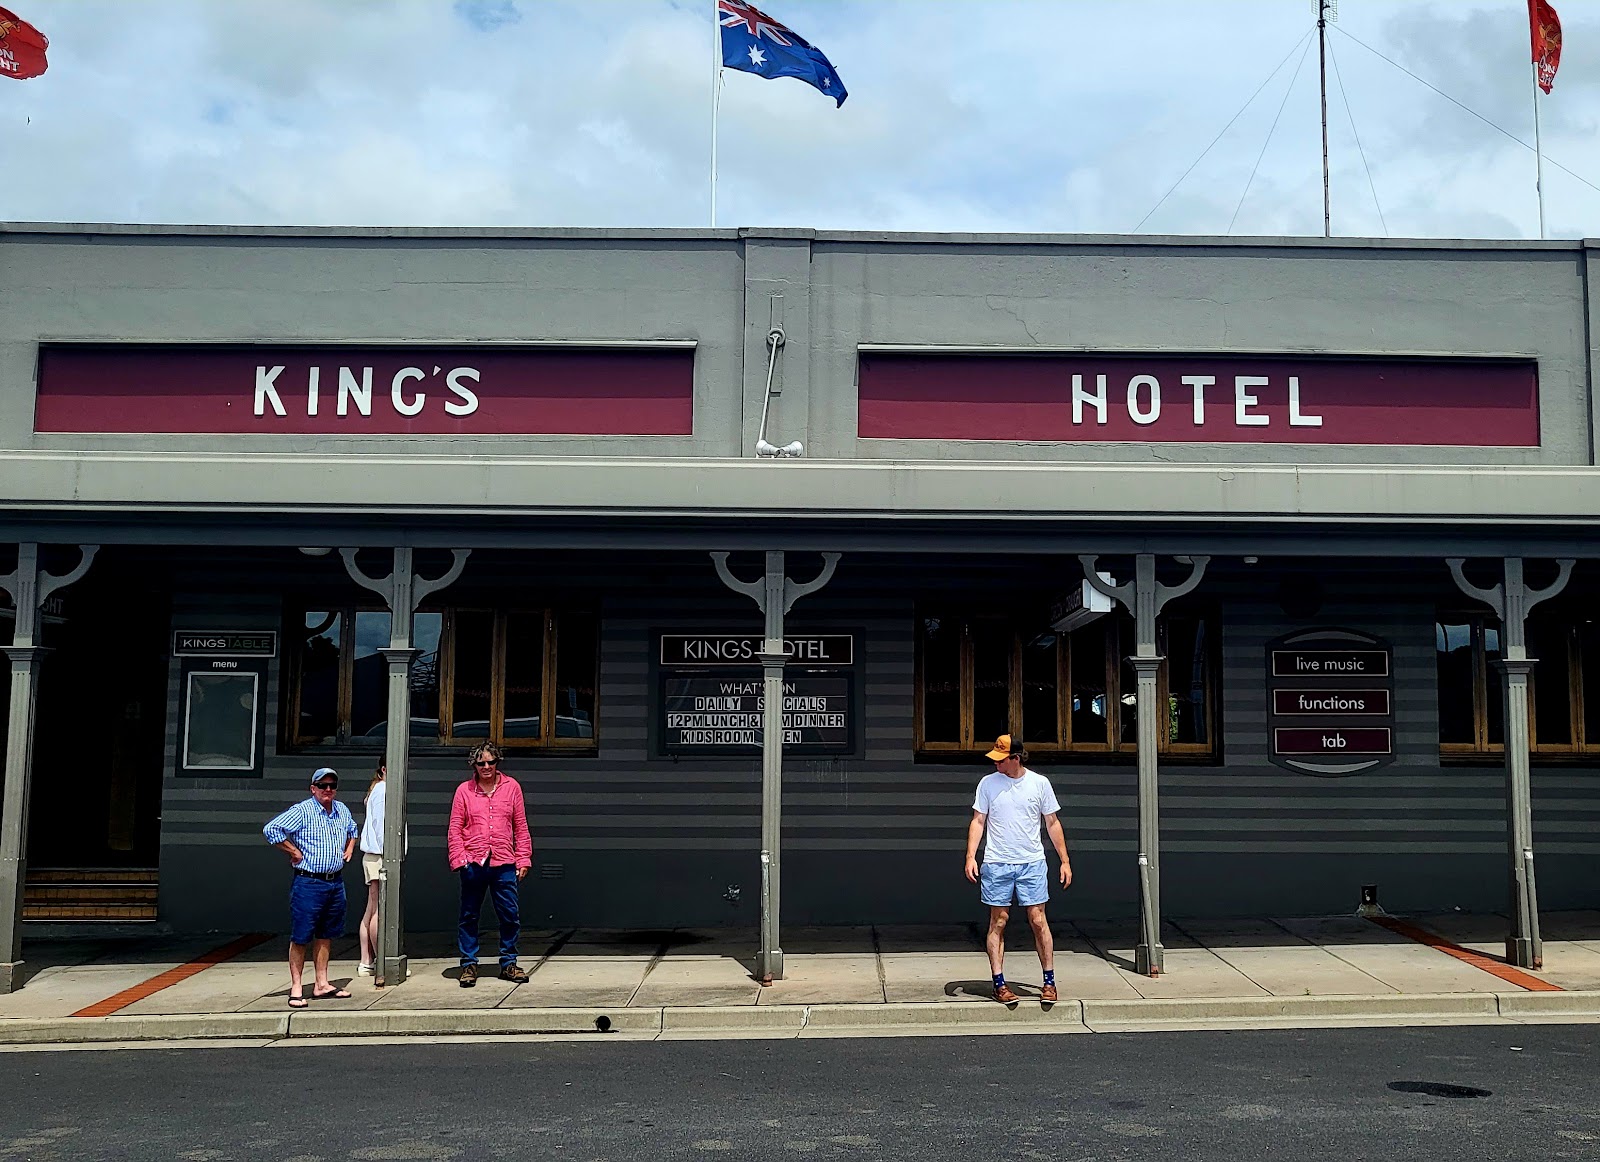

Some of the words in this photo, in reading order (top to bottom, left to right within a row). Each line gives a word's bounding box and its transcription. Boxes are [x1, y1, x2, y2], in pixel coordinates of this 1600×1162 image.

[254, 365, 481, 416] KING'S
[1072, 374, 1323, 426] HOTEL
[683, 640, 752, 659] KINGS
[212, 660, 238, 669] menu
[1296, 656, 1320, 670] live
[1324, 657, 1365, 670] music
[695, 697, 741, 711] DAILY
[757, 697, 826, 711] SCIALS
[1298, 695, 1365, 710] functions
[794, 713, 845, 728] DINNER
[781, 730, 802, 744] EN
[1321, 733, 1347, 748] tab
